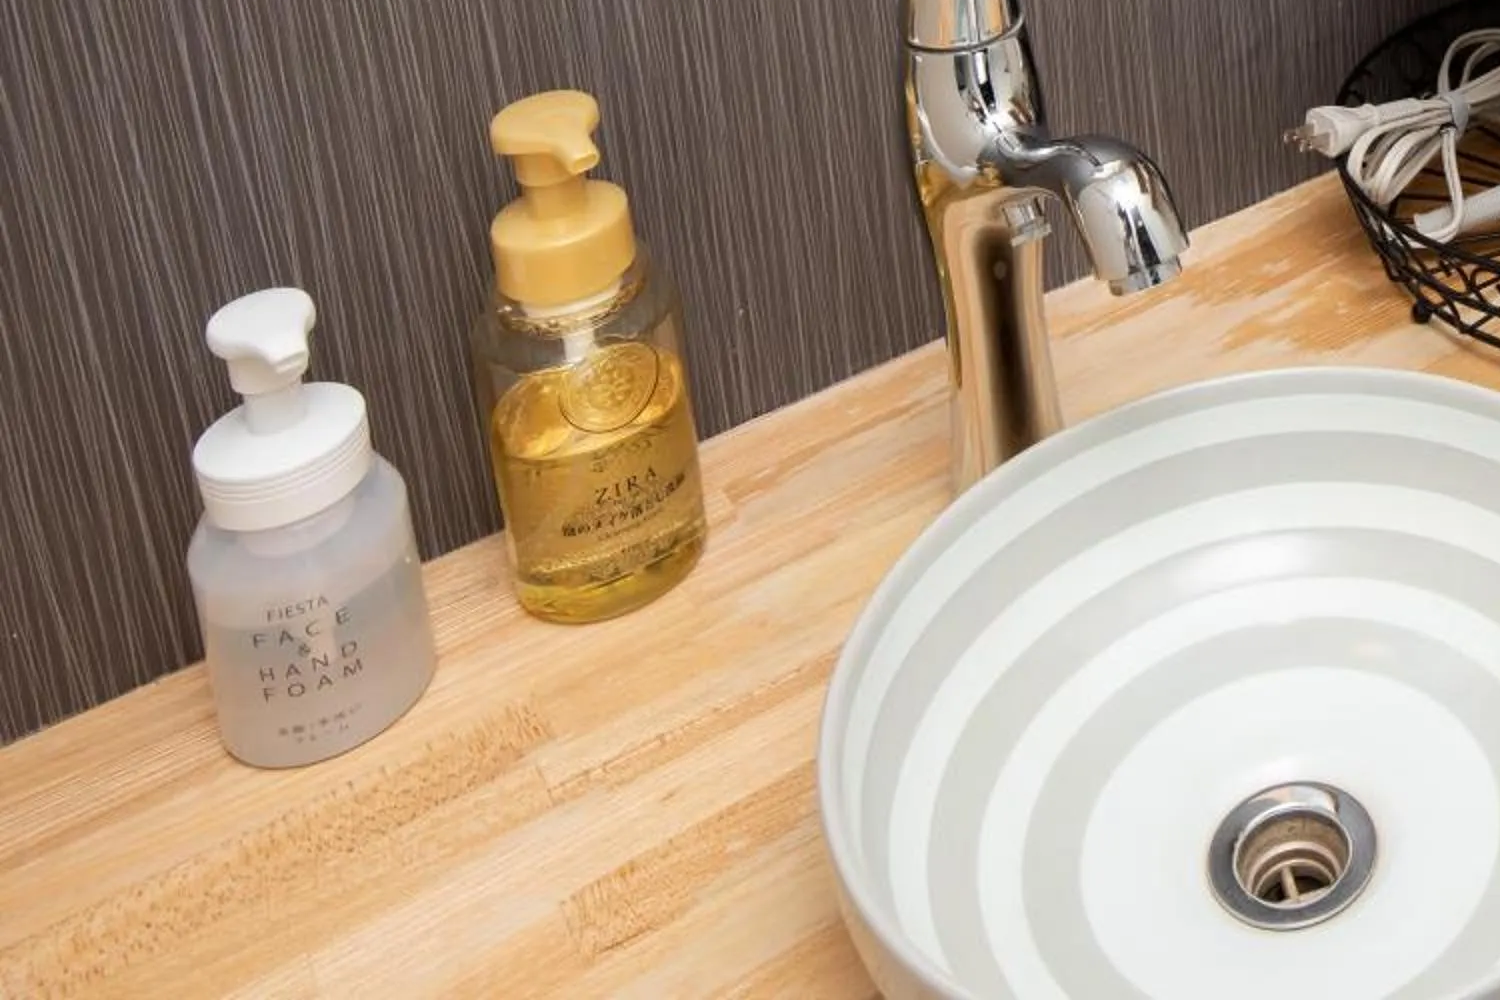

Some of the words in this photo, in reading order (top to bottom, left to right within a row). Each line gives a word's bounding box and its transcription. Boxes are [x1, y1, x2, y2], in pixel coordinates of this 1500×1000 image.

[594, 466, 657, 505] ZIRA
[252, 605, 351, 649] FACE
[266, 595, 330, 623] FIESTA
[258, 639, 358, 682] HAND
[262, 657, 363, 703] FOAM
